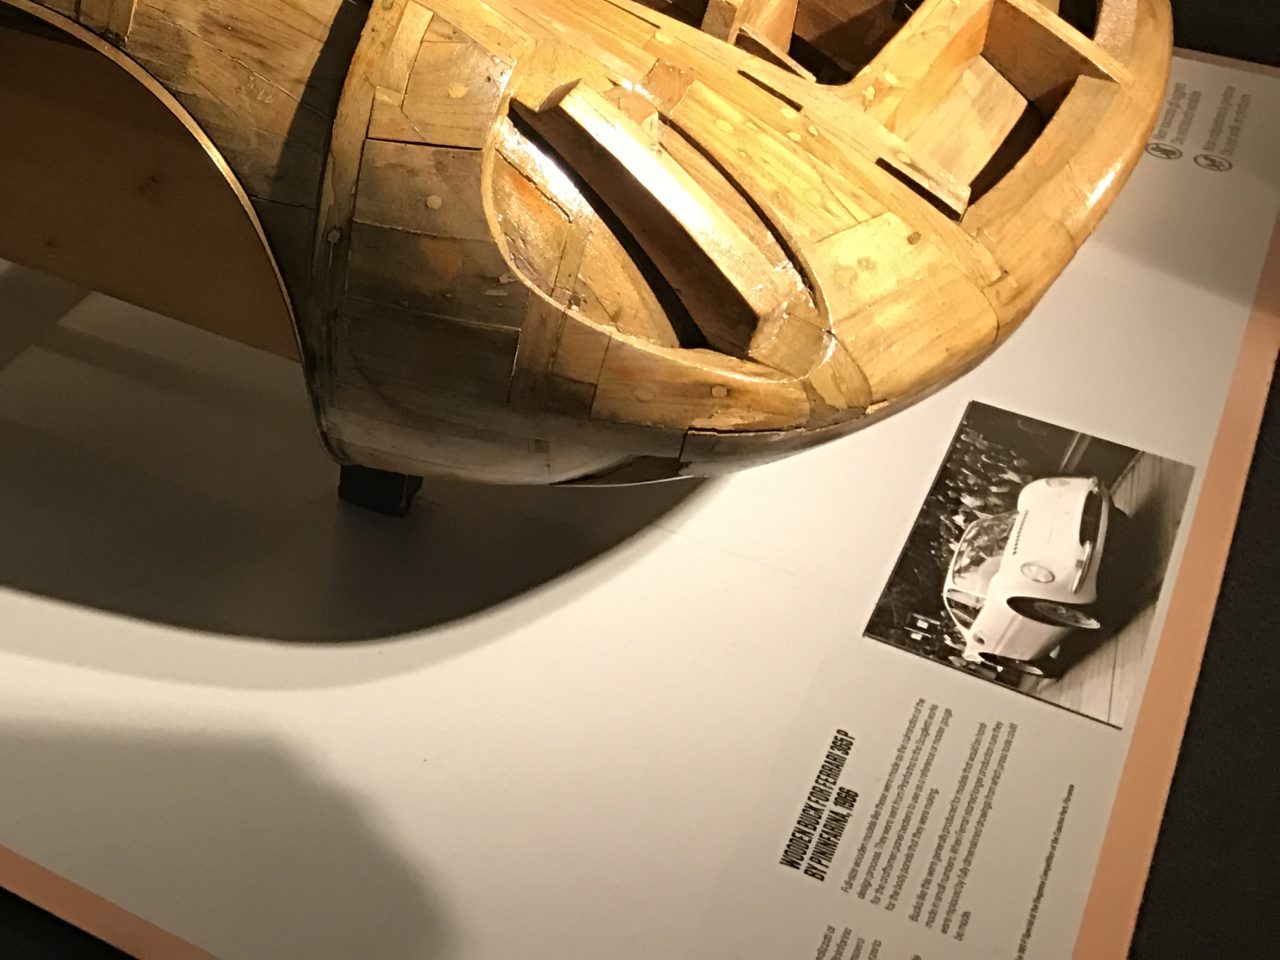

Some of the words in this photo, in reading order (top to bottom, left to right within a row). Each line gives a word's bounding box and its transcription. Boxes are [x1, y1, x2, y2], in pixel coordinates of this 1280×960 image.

[829, 735, 853, 756] 365
[835, 728, 855, 740] P
[814, 750, 847, 790] FERRARI
[807, 785, 832, 807] FOR
[832, 786, 858, 811] 1966
[796, 801, 825, 832] BUCK
[779, 826, 814, 870] WOODEN
[808, 809, 852, 868] PININFARINA,
[803, 862, 827, 881] BY
